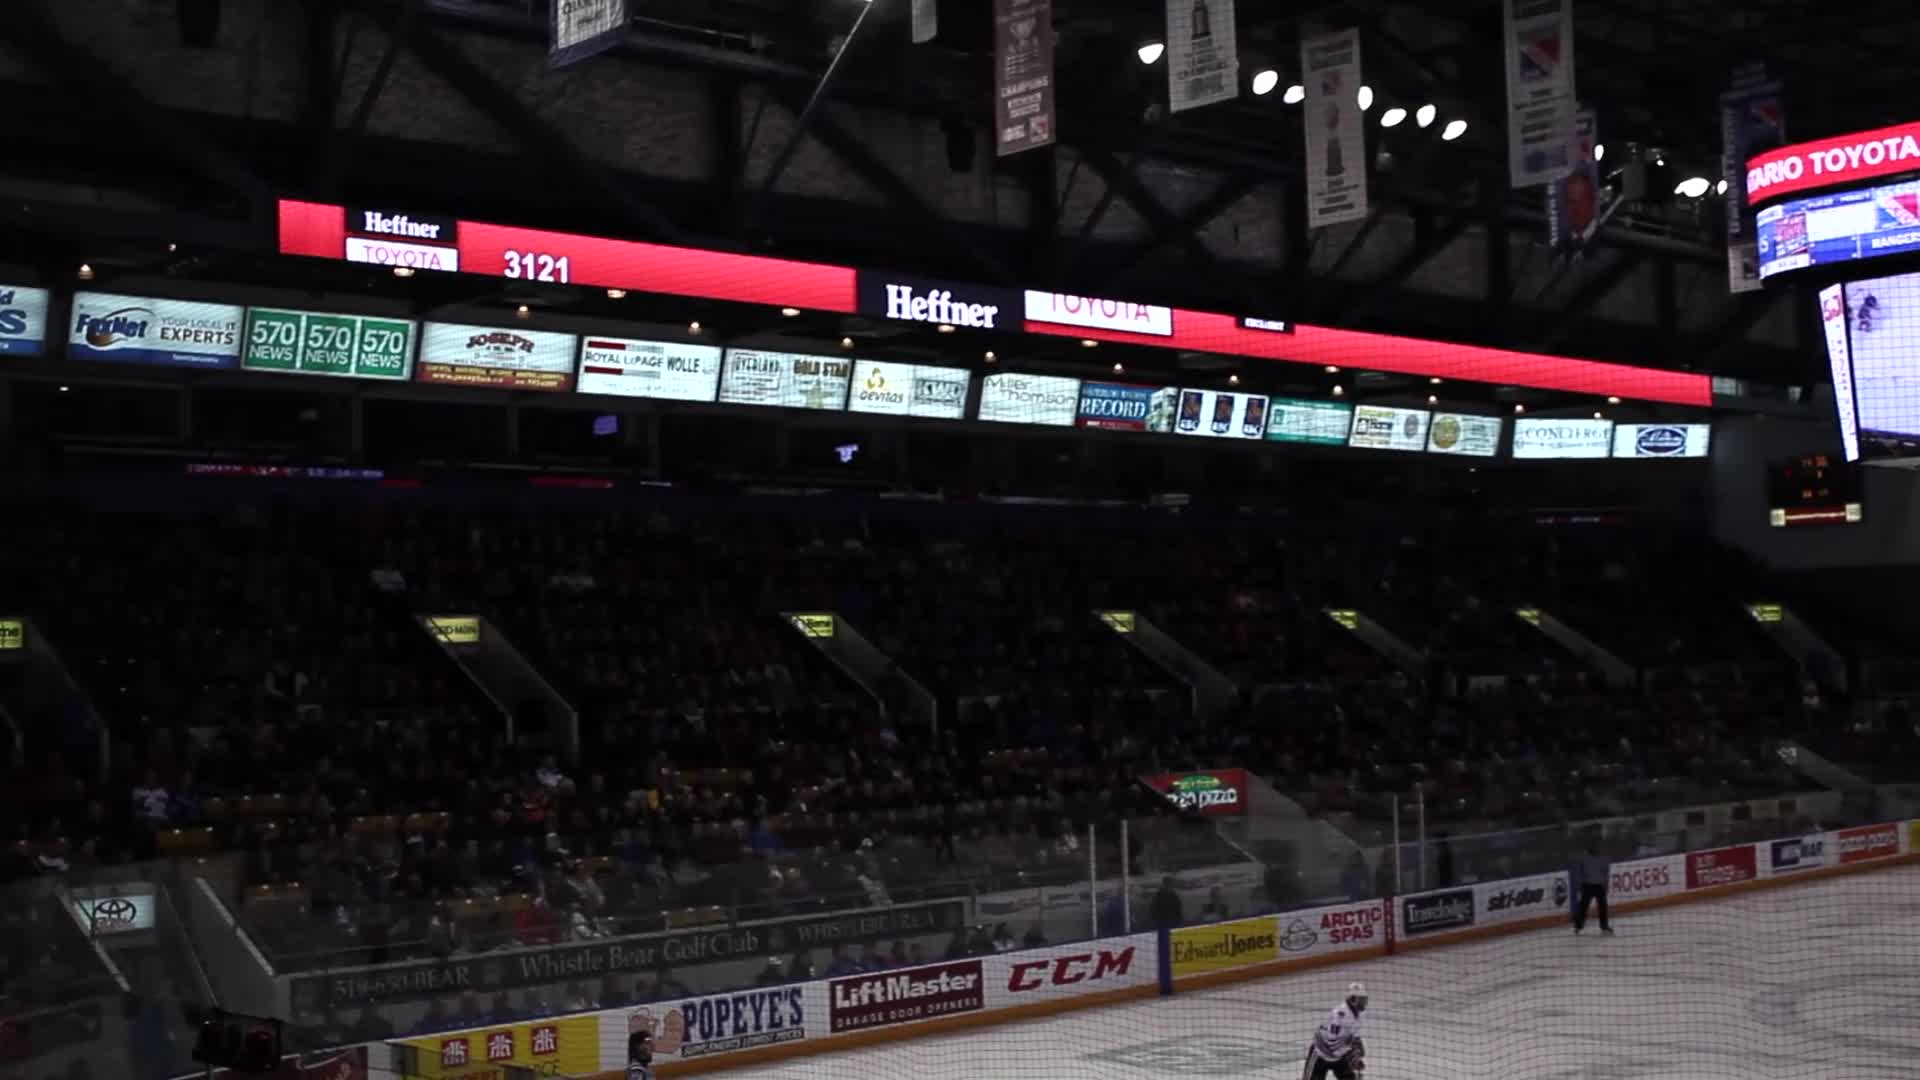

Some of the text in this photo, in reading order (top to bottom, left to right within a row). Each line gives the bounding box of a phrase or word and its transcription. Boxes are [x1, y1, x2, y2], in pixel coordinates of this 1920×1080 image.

[1808, 135, 1920, 175] TOYOTA
[364, 210, 440, 239] Heffner
[363, 245, 442, 270] TOYOTA
[504, 250, 568, 284] 3121
[886, 284, 998, 329] Heffner
[1050, 292, 1151, 322] TOYOTA
[160, 327, 234, 345] EXPERTS
[252, 320, 296, 345] 570
[308, 325, 351, 350] 570
[363, 329, 404, 353] 570
[250, 344, 293, 361] NEWS
[305, 349, 348, 365] NEWS
[360, 353, 401, 369] NEWS
[1079, 398, 1147, 418] RECORD
[1612, 864, 1670, 893] ROGERS
[1320, 906, 1383, 930] ARCTIC
[1329, 925, 1374, 944] SPAS
[520, 953, 604, 980] Whistle
[609, 945, 656, 969] Bear
[1008, 946, 1135, 993] CCM
[835, 970, 979, 1010] LiftMaster
[682, 987, 803, 1042] POPEYE'S
